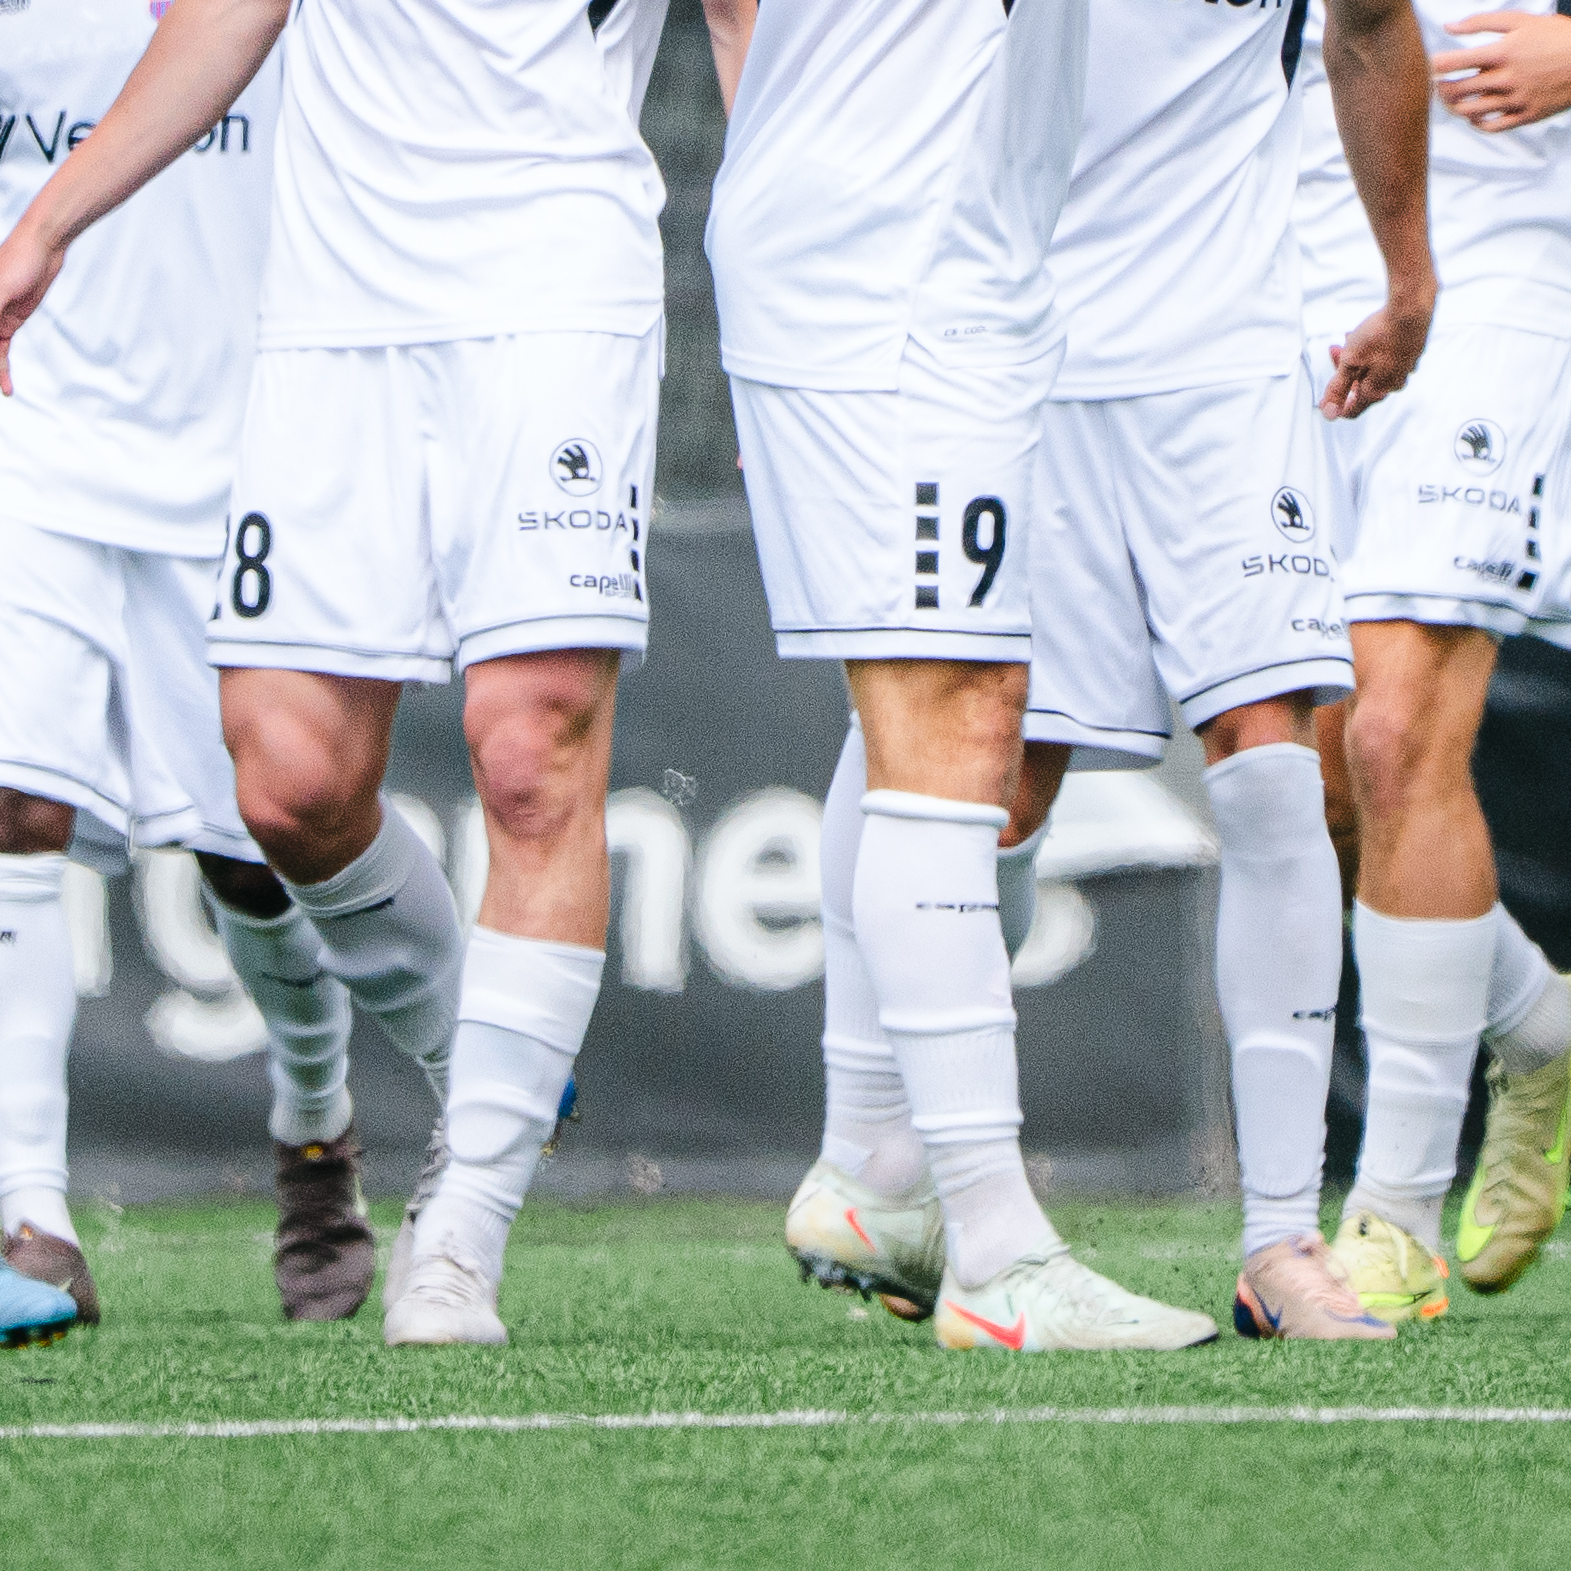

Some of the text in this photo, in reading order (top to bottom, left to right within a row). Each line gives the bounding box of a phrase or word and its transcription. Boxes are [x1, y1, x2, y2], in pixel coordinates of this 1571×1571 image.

[230, 510, 272, 619] 8
[960, 494, 1007, 608] 9
[1242, 554, 1335, 582] SKOD
